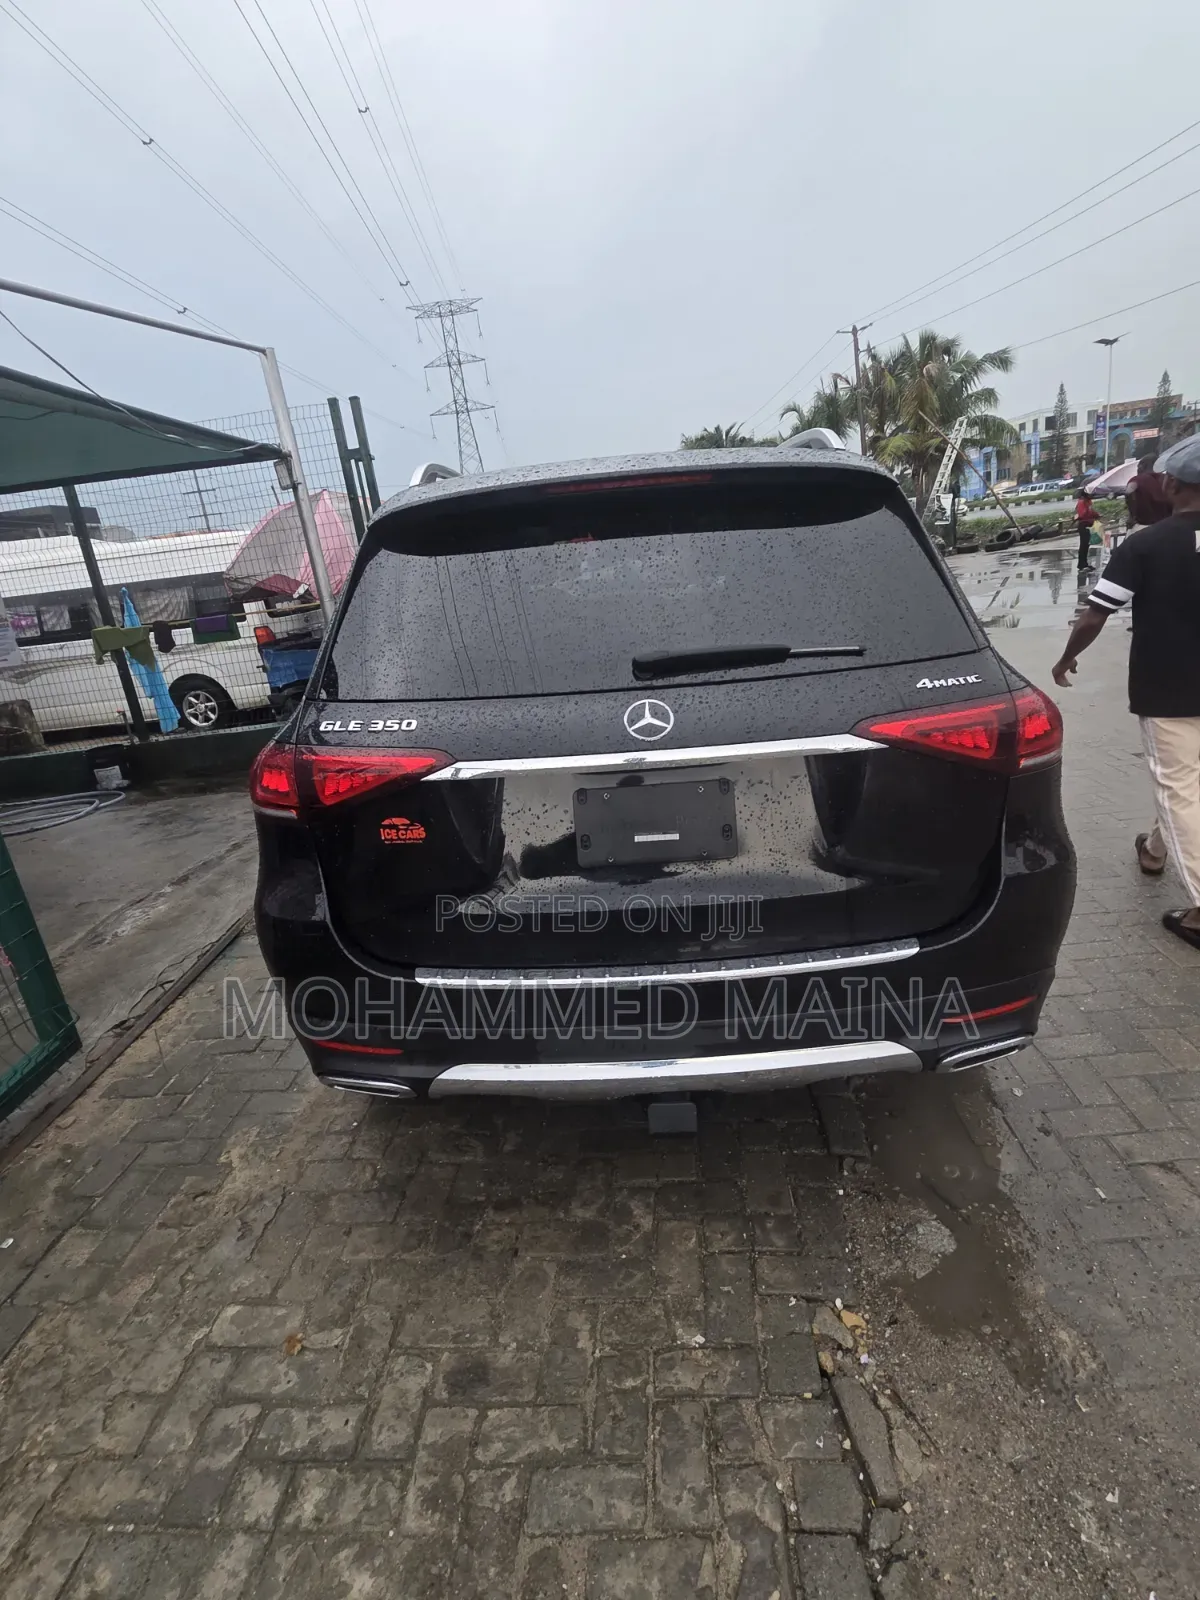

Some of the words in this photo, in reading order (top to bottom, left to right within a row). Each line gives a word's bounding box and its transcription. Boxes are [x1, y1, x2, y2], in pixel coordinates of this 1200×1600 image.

[916, 674, 983, 689] 4MATIC
[319, 720, 364, 732] GLE
[367, 719, 418, 731] 350
[380, 828, 398, 840] ICE
[398, 827, 426, 839] CARS
